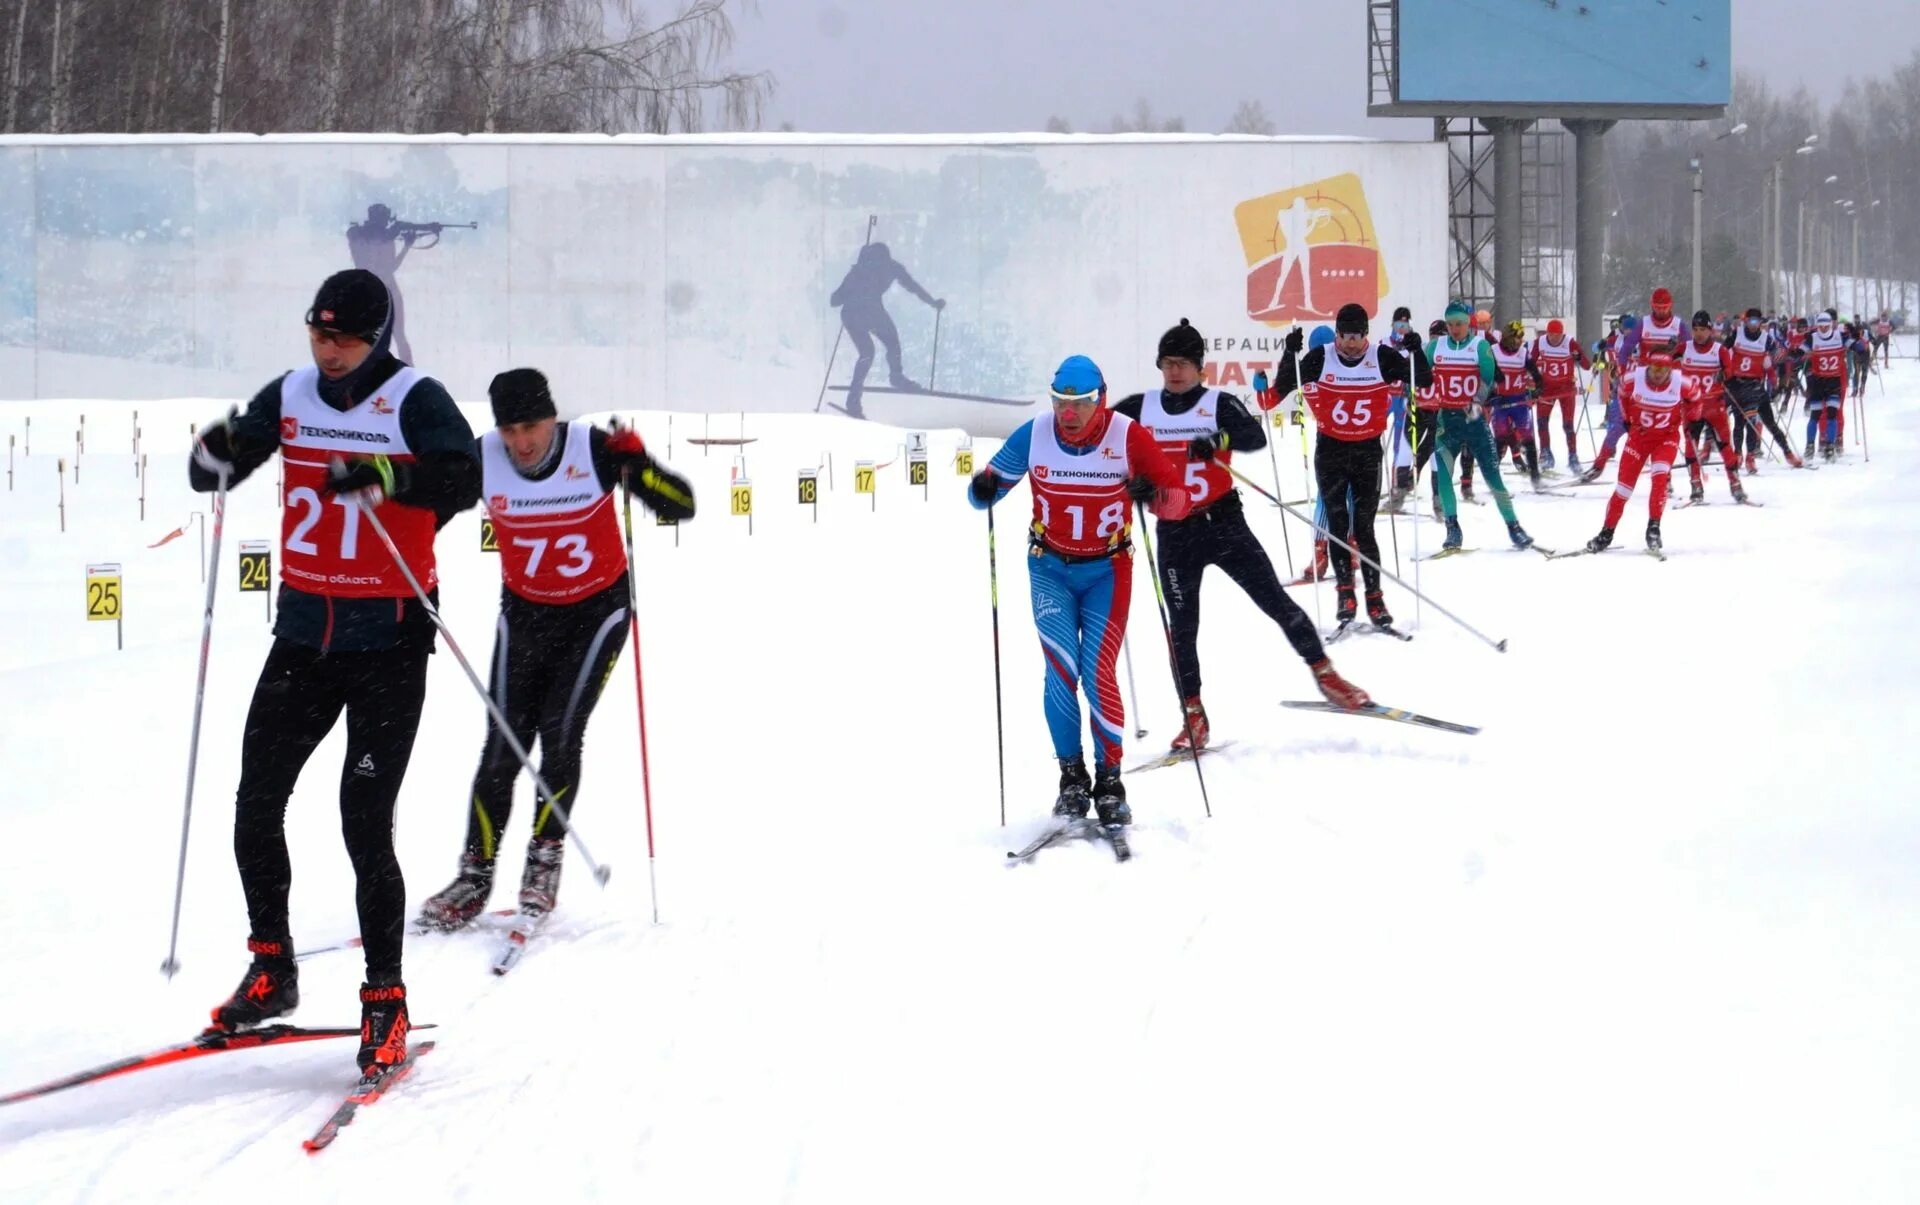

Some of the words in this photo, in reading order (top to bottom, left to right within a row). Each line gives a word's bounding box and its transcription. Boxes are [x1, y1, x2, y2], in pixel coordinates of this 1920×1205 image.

[1203, 338, 1285, 353] ДЕРАЦИ
[1740, 357, 1751, 371] 8
[1819, 356, 1839, 370] 32
[1332, 399, 1372, 426] 65
[1640, 411, 1672, 429] 52
[299, 425, 392, 444] ТЕХНОНИКОЛЬ
[911, 463, 926, 483] 16
[957, 454, 972, 474] 15
[856, 470, 873, 491] 17
[1051, 470, 1122, 480] ТЕХНОНИКОЛЬ
[799, 479, 815, 502] 18
[733, 489, 750, 513] 19
[286, 486, 361, 560] 21
[1036, 494, 1125, 541] 118
[512, 533, 594, 578] 73
[241, 556, 269, 589] 24
[328, 574, 383, 585] область
[89, 582, 119, 616] 25
